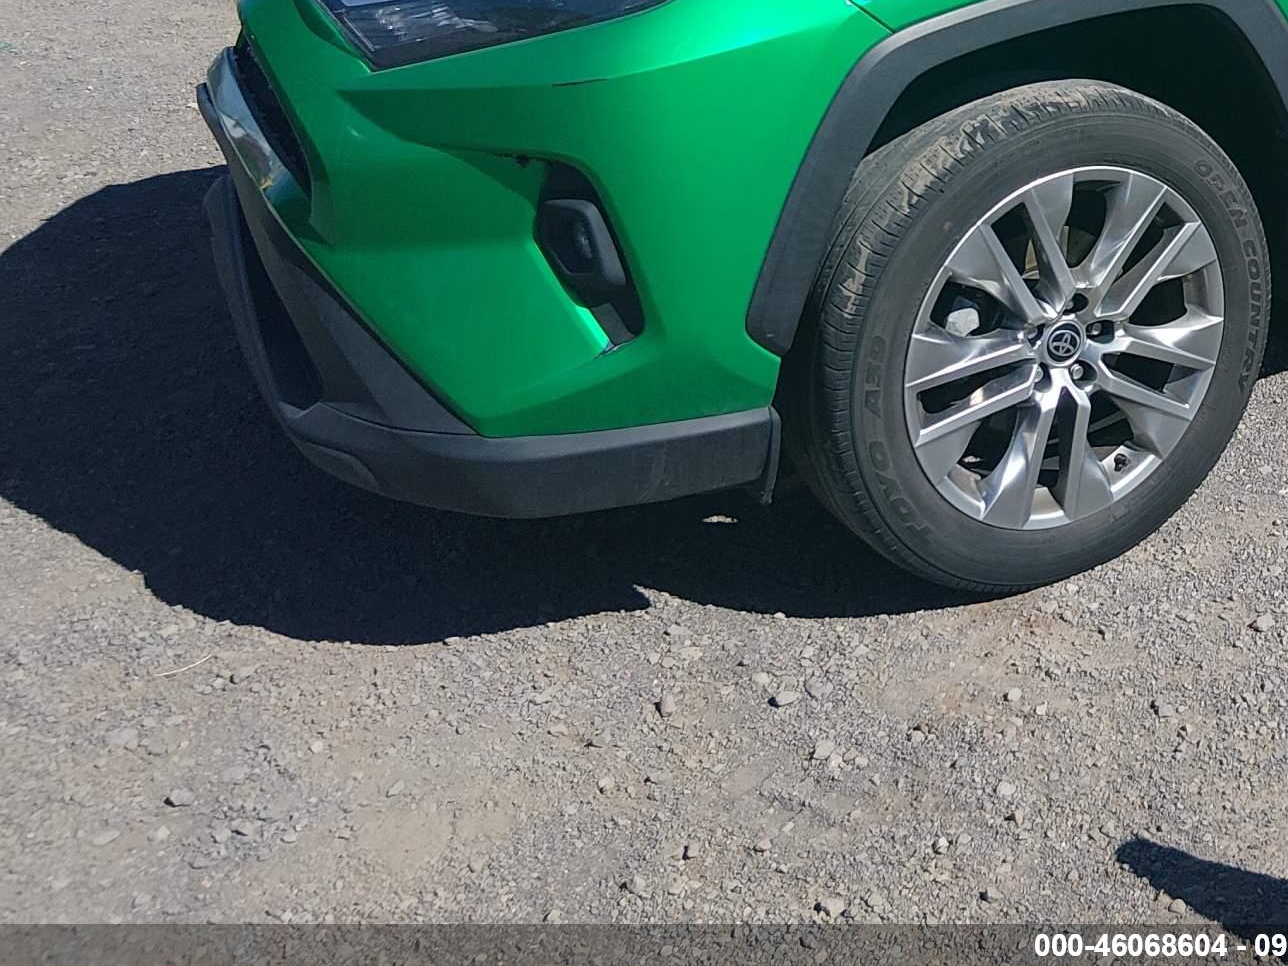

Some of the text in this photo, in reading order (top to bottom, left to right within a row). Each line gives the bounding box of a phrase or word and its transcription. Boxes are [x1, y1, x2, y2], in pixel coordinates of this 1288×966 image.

[1193, 158, 1264, 395] OPEN COUNTRY
[868, 440, 931, 537] TOYO
